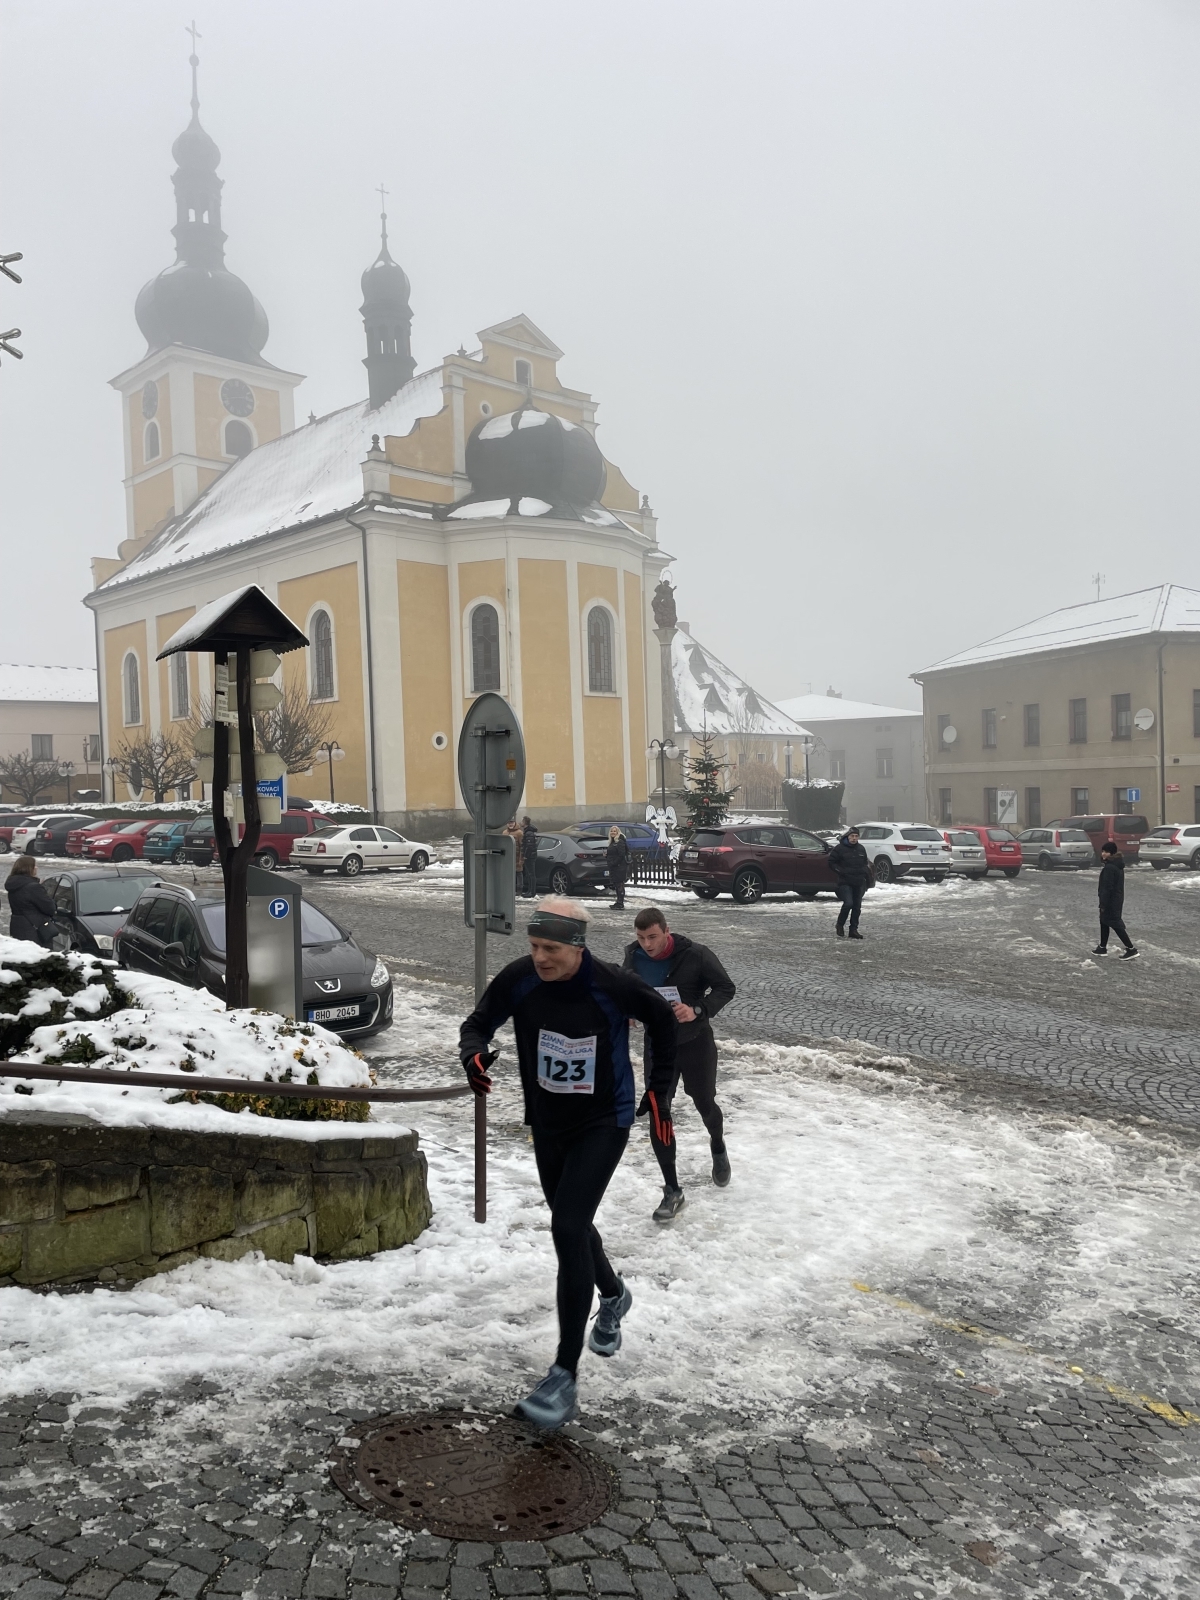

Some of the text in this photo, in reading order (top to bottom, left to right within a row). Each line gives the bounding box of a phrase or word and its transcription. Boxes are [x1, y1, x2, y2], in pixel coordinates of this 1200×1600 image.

[275, 902, 285, 915] P
[336, 1006, 356, 1017] 2045
[543, 1055, 587, 1082] 123
